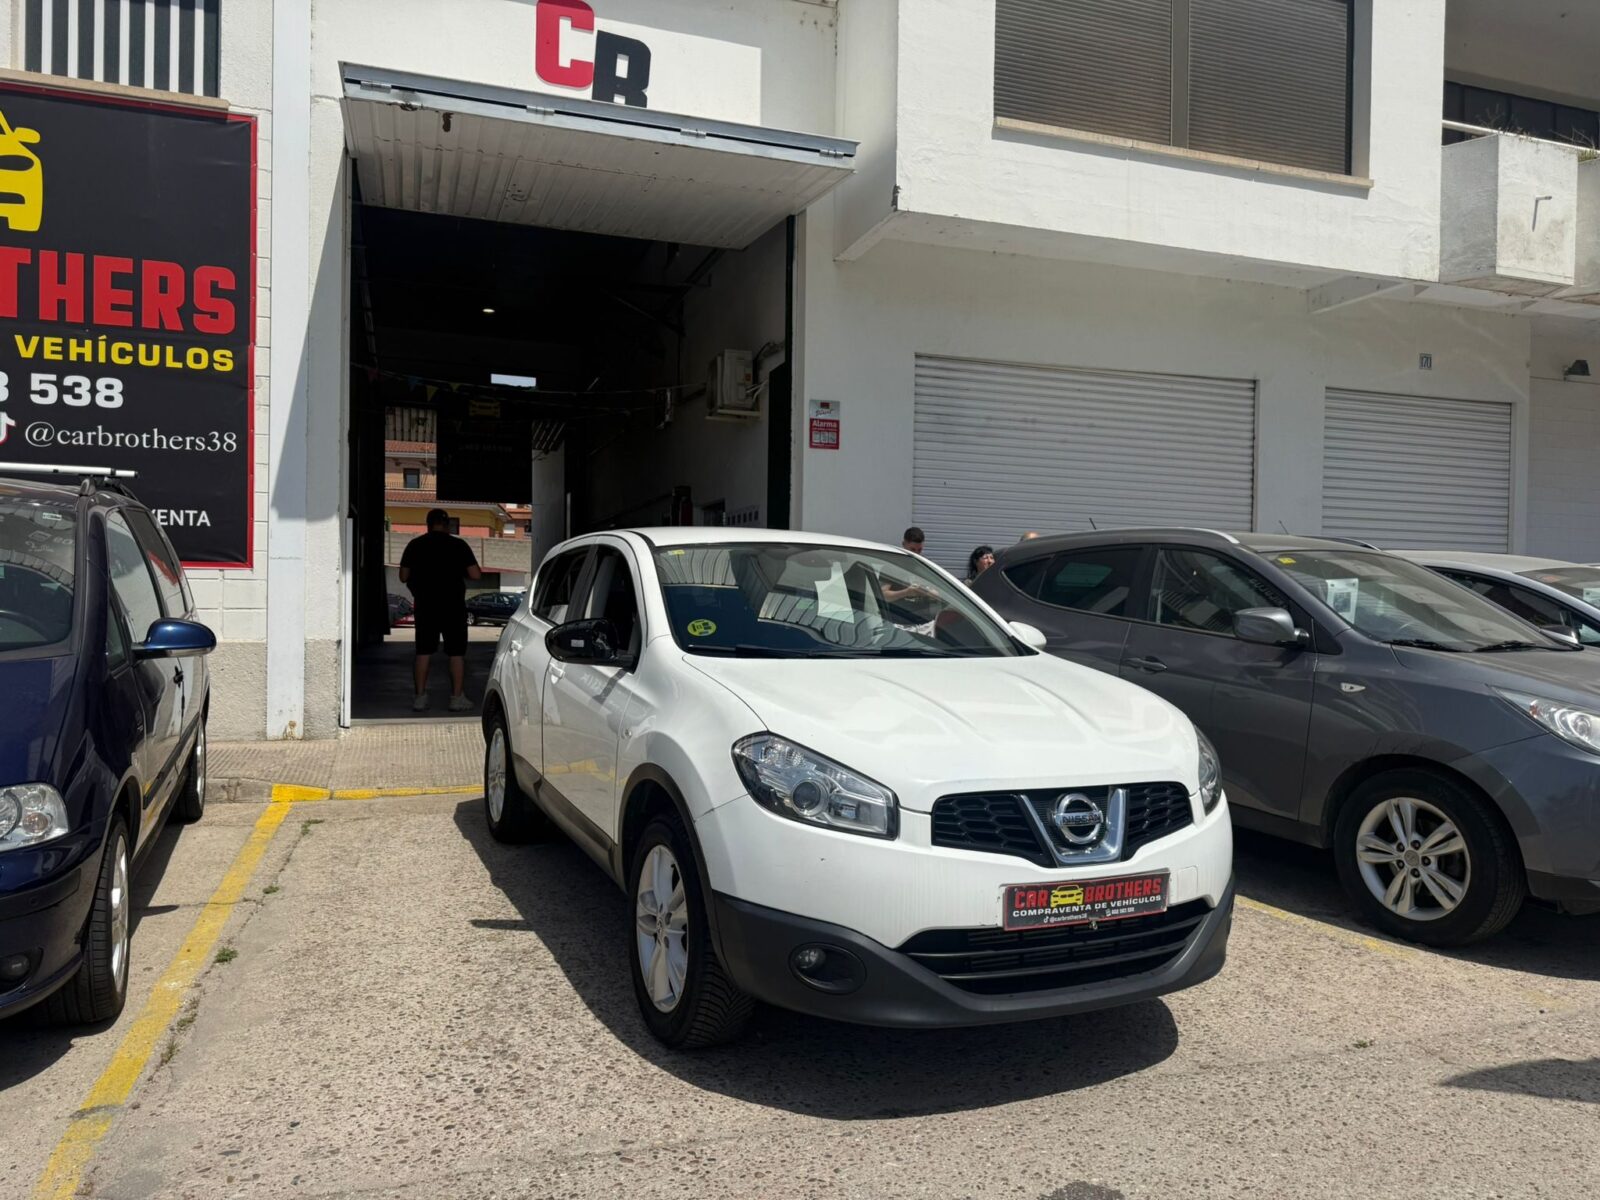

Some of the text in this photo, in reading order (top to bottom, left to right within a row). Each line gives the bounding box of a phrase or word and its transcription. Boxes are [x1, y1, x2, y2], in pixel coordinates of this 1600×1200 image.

[14, 334, 235, 372] VEHÍCULOS
[29, 372, 124, 409] 538
[25, 421, 237, 452] @carbrothers38
[812, 420, 837, 428] Alarma
[151, 508, 211, 526] ENTA
[1062, 813, 1101, 823] NISSAN
[1012, 895, 1162, 918] COMPRAVENTA DE VEHÍCULOS
[1014, 879, 1161, 909] CAR BROTHERS
